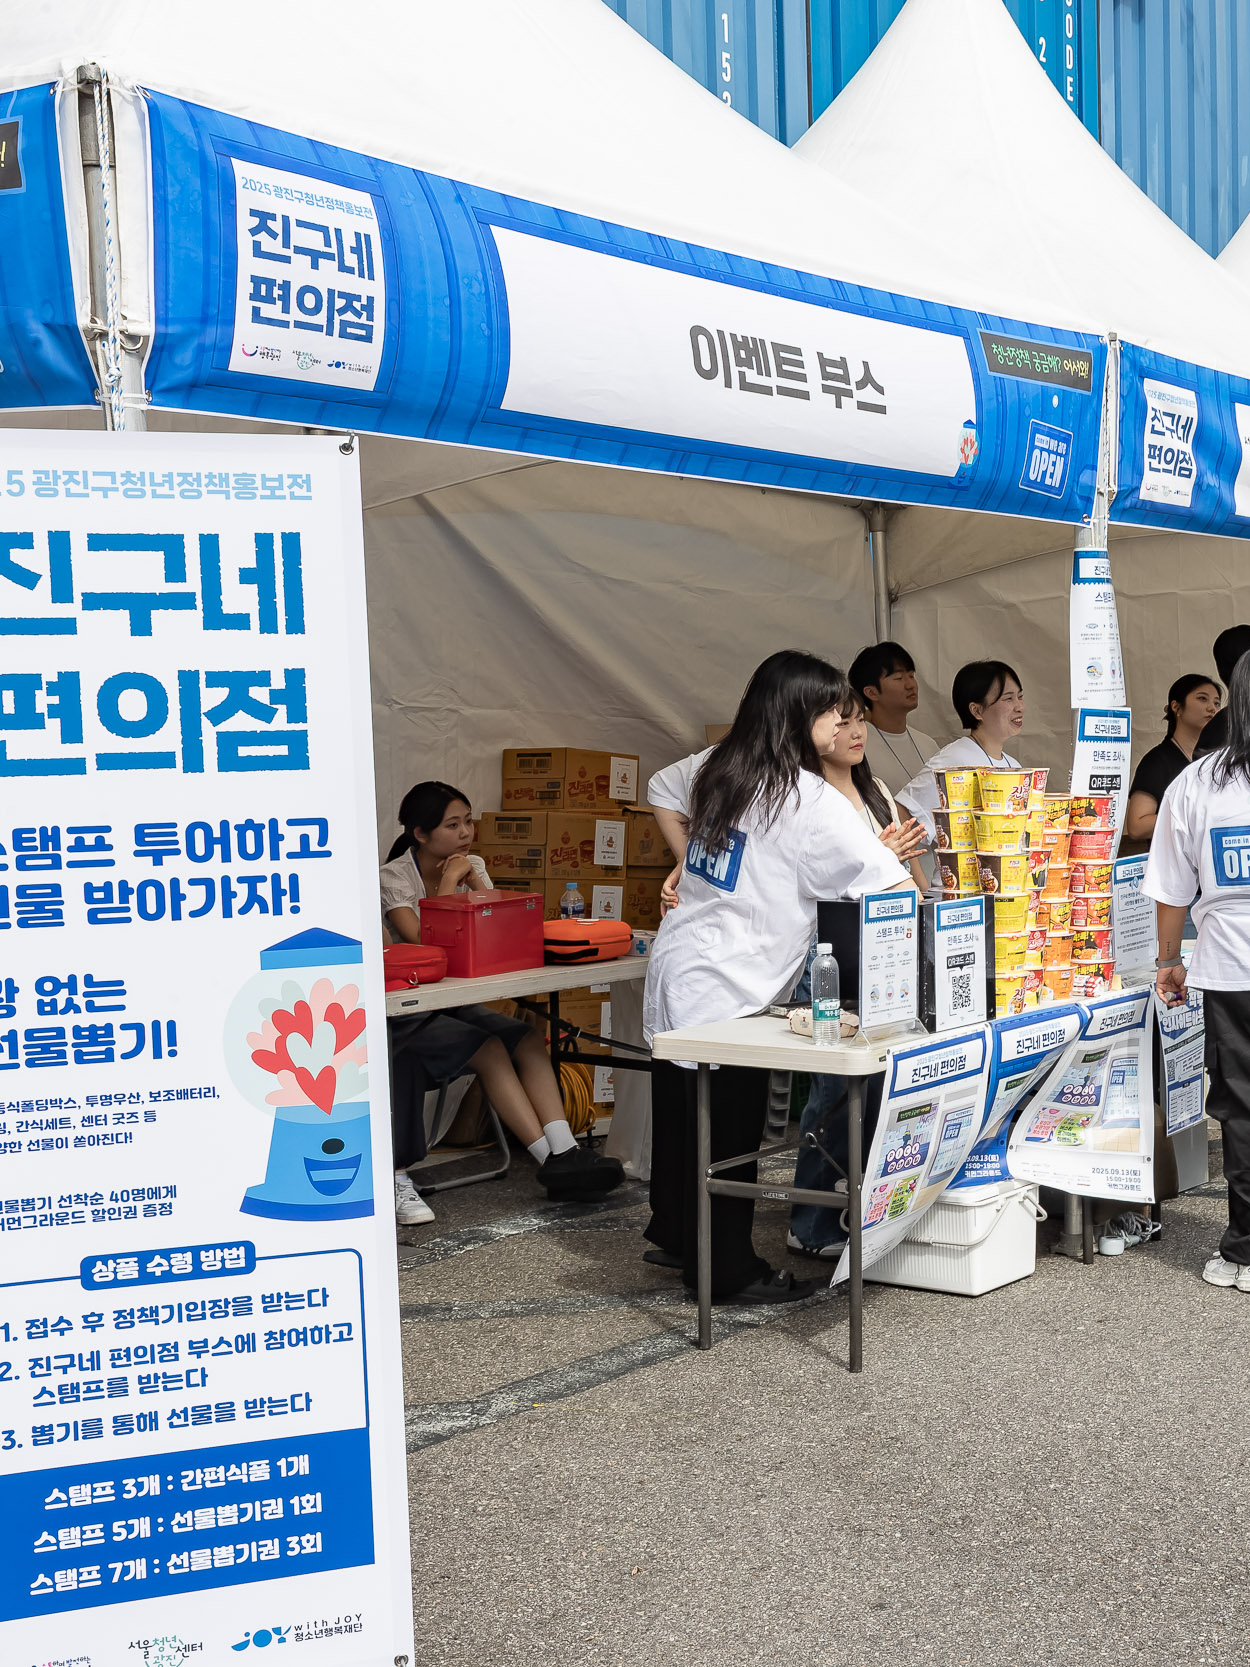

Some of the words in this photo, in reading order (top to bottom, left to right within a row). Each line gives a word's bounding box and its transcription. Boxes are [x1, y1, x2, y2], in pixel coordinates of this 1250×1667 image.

[1065, 0, 1074, 102] ODE
[241, 176, 272, 196] 2025
[272, 182, 374, 221] 광진구청년정책홍보전
[247, 207, 376, 283] 진구네
[248, 273, 376, 346] 편의점
[689, 323, 812, 401] 이벤트
[816, 350, 888, 416] 부스
[991, 342, 1032, 370] 청년정책
[1032, 351, 1062, 374] 궁금해?
[1150, 406, 1194, 445] 진구네
[1049, 438, 1058, 452] we
[1057, 441, 1067, 455] are
[1147, 443, 1193, 480] 편의점
[31, 469, 313, 501] 광진구청년정책홍보전
[1028, 448, 1065, 489] OPEN
[1093, 750, 1112, 762] 만족도
[0, 823, 117, 873] 탬프
[132, 816, 333, 867] 투어하고
[1224, 836, 1241, 846] come
[0, 881, 66, 931] 물
[83, 871, 302, 927] 받아가자!
[875, 926, 893, 939] 스탬프
[963, 932, 975, 944] 조사
[34, 971, 128, 1018] 없는
[1099, 1016, 1117, 1031] 진구네
[1117, 1010, 1136, 1026] 편의점
[1016, 1036, 1041, 1055] 진구네
[1041, 1028, 1066, 1049] 편의점
[911, 1063, 939, 1084] 진구네
[940, 1054, 967, 1076] 편의점
[85, 1091, 145, 1108] 투명우산,
[148, 1085, 221, 1103] 보조배터리,
[15, 1116, 77, 1135] 간식세트,
[80, 1113, 109, 1128] 센터
[111, 1111, 140, 1127] 굿즈
[143, 1109, 158, 1123] 등
[26, 1136, 70, 1153] 선물이
[72, 1131, 134, 1149] 쏟아진다!
[0, 1196, 52, 1215] 물뽑기
[56, 1191, 105, 1209] 선착순
[108, 1184, 178, 1205] 40명에게
[90, 1205, 138, 1224] 할인권
[141, 1201, 174, 1218] 증정
[90, 1253, 140, 1283] 상품
[145, 1250, 193, 1279] 수령
[199, 1245, 246, 1273] 방법
[1, 1322, 18, 1344] 1.
[24, 1315, 74, 1341] 접수
[81, 1310, 106, 1334] 후
[112, 1294, 254, 1331] 정책기입장을
[260, 1286, 330, 1317] 받는다
[0, 1361, 20, 1382] 2.
[27, 1350, 102, 1380] 진구네
[109, 1339, 181, 1369] 편의점
[187, 1331, 257, 1361] 부스에
[263, 1321, 355, 1352] 참여하고
[31, 1374, 130, 1408] 스탬프를
[136, 1366, 209, 1396] 받는다
[1, 1428, 24, 1451] 3.
[30, 1415, 105, 1448] 뽑기를
[112, 1408, 160, 1437] 통해
[166, 1400, 238, 1431] 선물을
[243, 1390, 313, 1421] 받는다
[44, 1479, 116, 1511] 스탬프
[121, 1473, 162, 1500] 3개
[180, 1458, 272, 1493] 간편식품
[275, 1452, 311, 1478] 1개
[32, 1521, 106, 1554] 스탬프
[111, 1515, 152, 1543] 5개
[170, 1496, 285, 1534] 선물뽑기권
[289, 1491, 323, 1518] 1회
[29, 1563, 102, 1597] 스탬프
[107, 1556, 148, 1585] 7개
[166, 1538, 282, 1576] 선물뽑기권
[285, 1531, 323, 1557] 3회
[230, 1623, 292, 1653] JOY
[293, 1619, 329, 1632] with
[333, 1613, 363, 1627] JOY
[293, 1621, 364, 1644] 청소년행복재단
